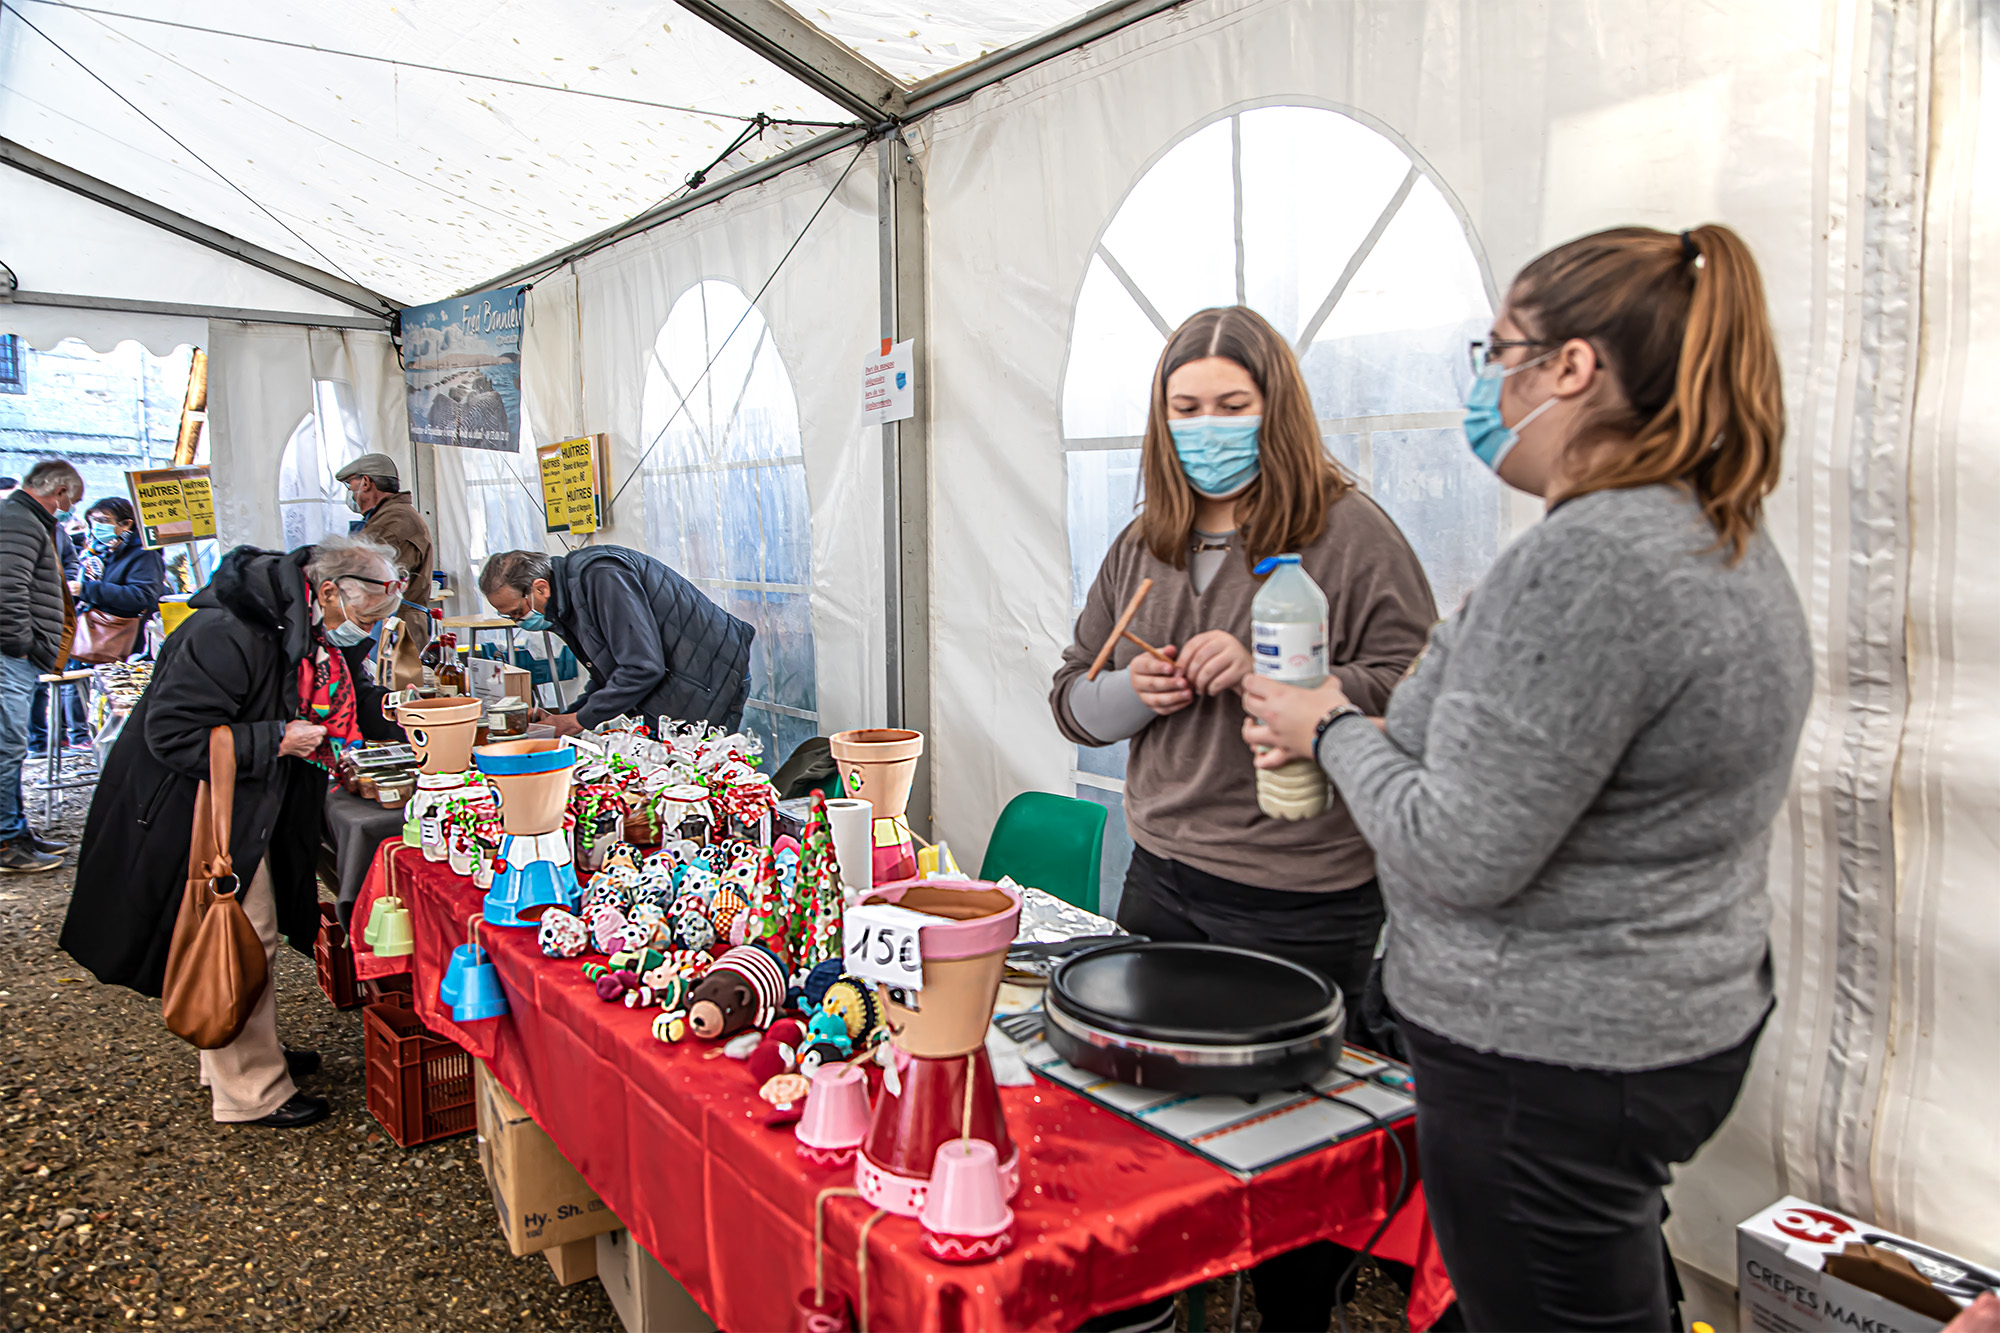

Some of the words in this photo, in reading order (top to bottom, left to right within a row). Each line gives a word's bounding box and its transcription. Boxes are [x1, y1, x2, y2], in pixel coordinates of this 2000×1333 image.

[463, 304, 481, 334] Fred
[138, 485, 180, 498] HUÎTRES
[850, 925, 921, 972] 15€
[524, 1213, 552, 1228] Hy.
[557, 1204, 584, 1219] Sh.
[1746, 1260, 1818, 1309] CREPES
